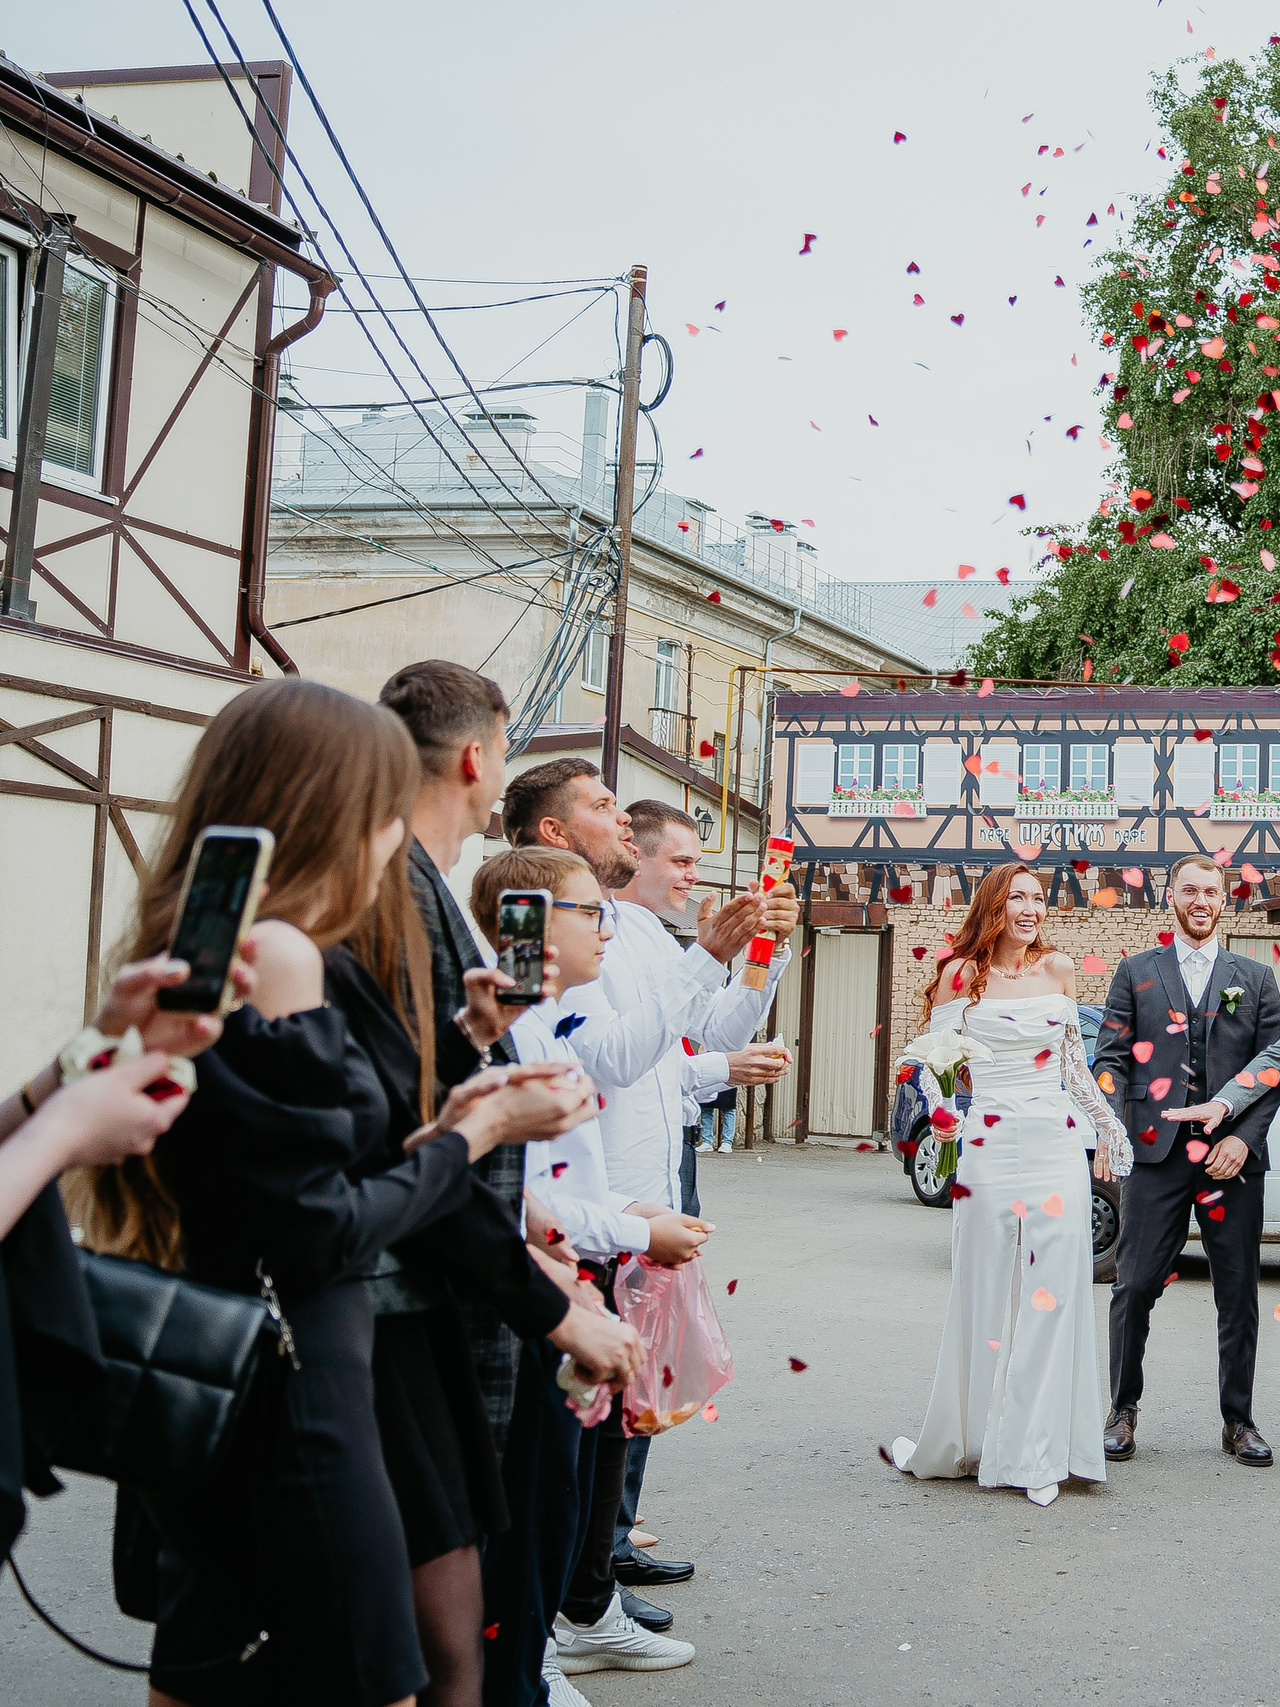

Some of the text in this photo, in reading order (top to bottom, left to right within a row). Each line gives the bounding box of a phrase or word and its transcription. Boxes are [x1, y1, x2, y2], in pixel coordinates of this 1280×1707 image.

[979, 822, 1147, 847] КАФЕ ПРЕСТИЖ КАФЕ
